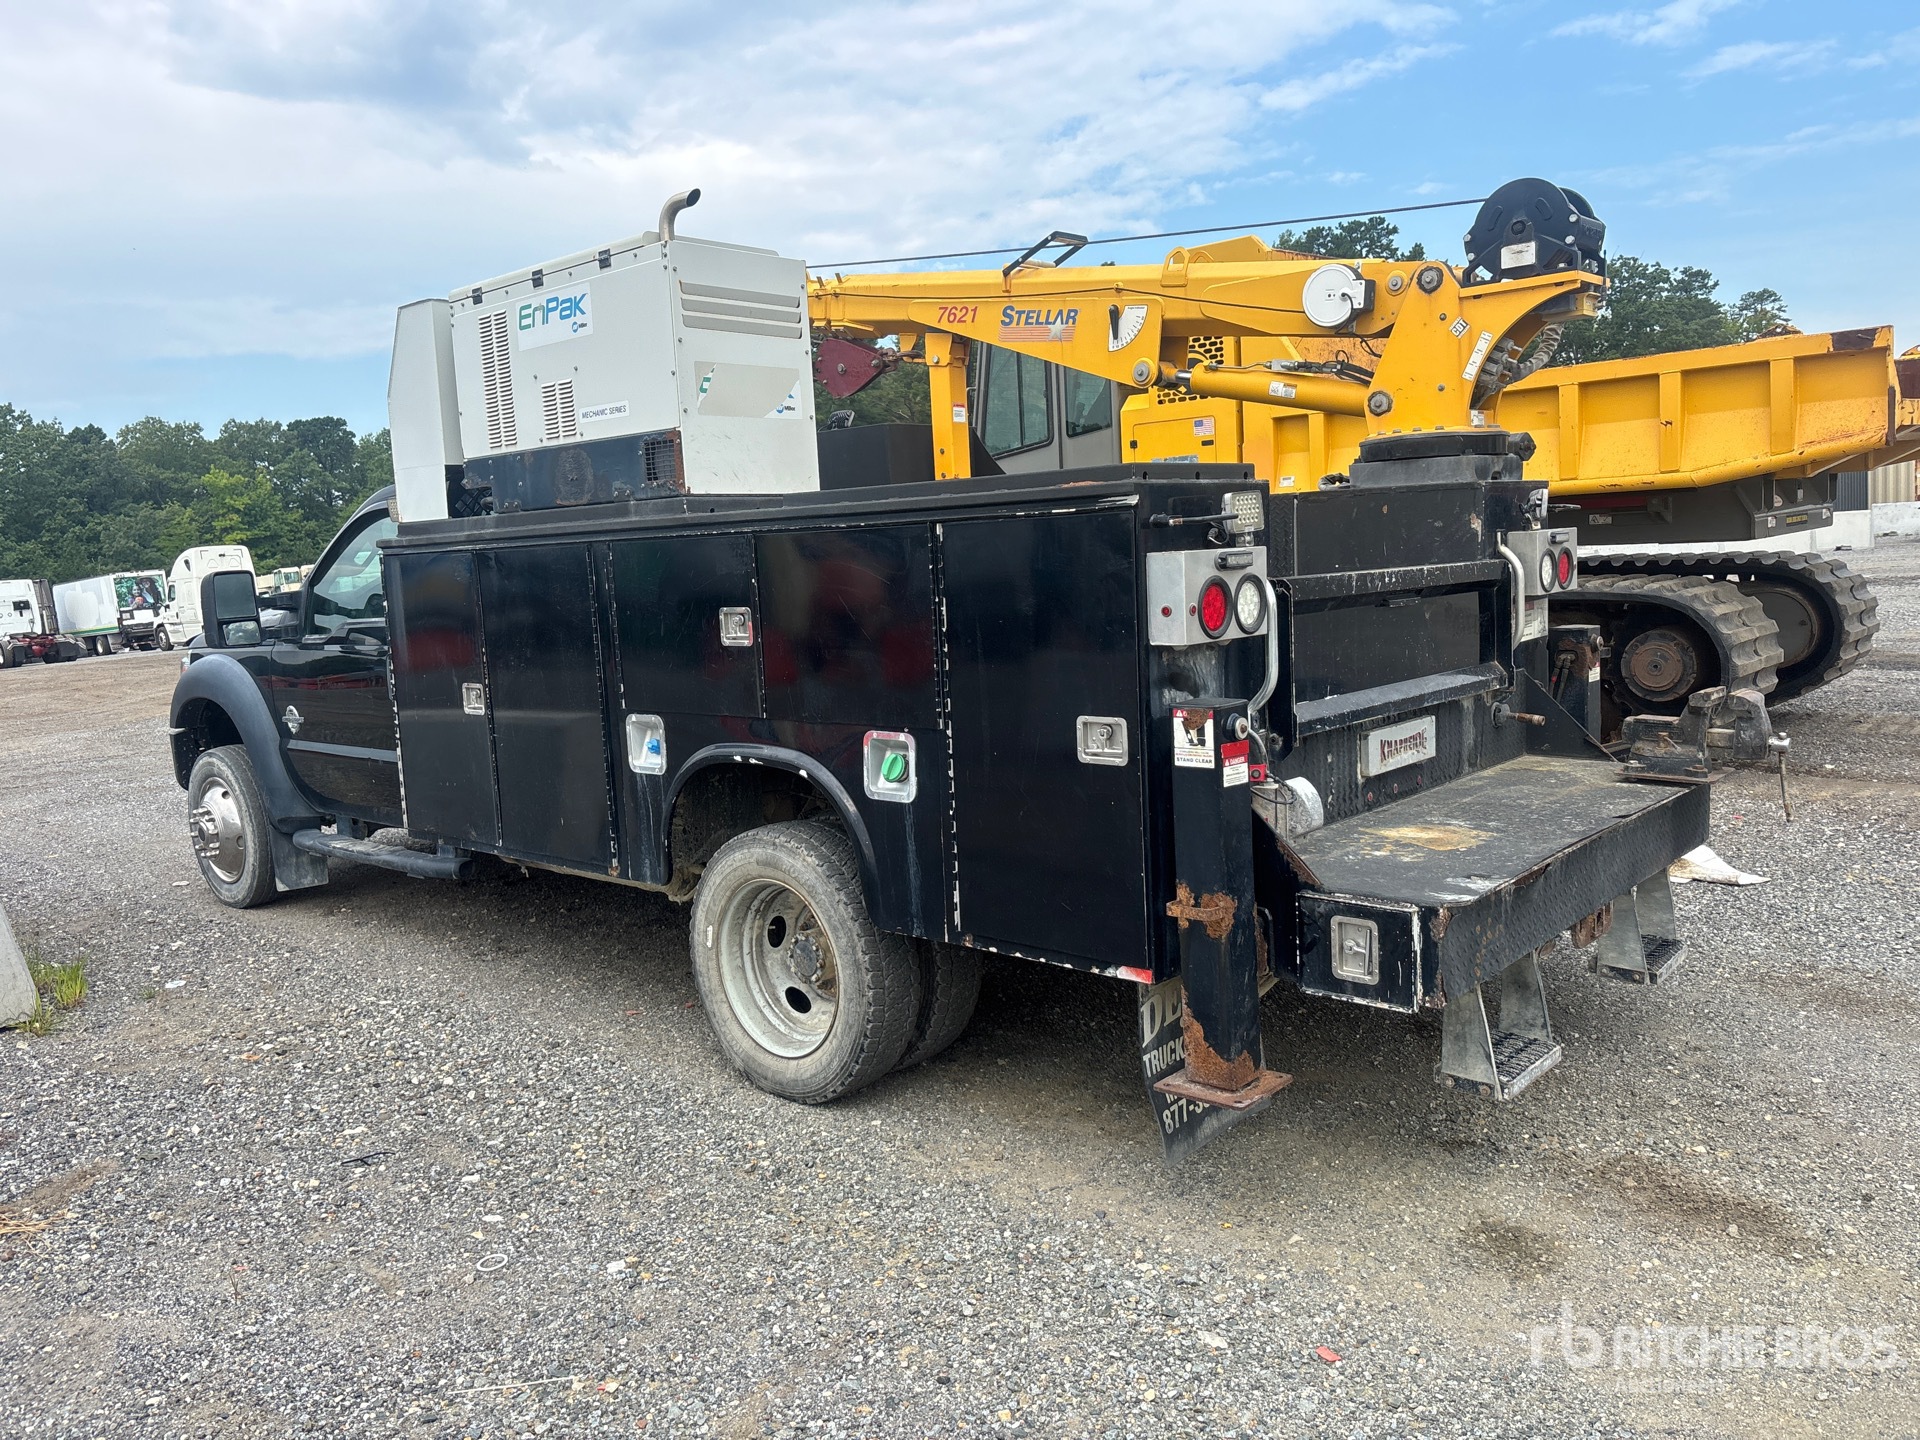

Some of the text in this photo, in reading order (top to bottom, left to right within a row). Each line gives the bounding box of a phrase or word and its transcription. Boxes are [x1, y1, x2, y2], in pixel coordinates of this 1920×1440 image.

[519, 293, 588, 331] EnPak
[937, 305, 1079, 327] 7621 STELLAR
[1451, 319, 1467, 336] CDT
[581, 404, 627, 419] MECHANIC SERIES
[1229, 756, 1245, 765] DANGER
